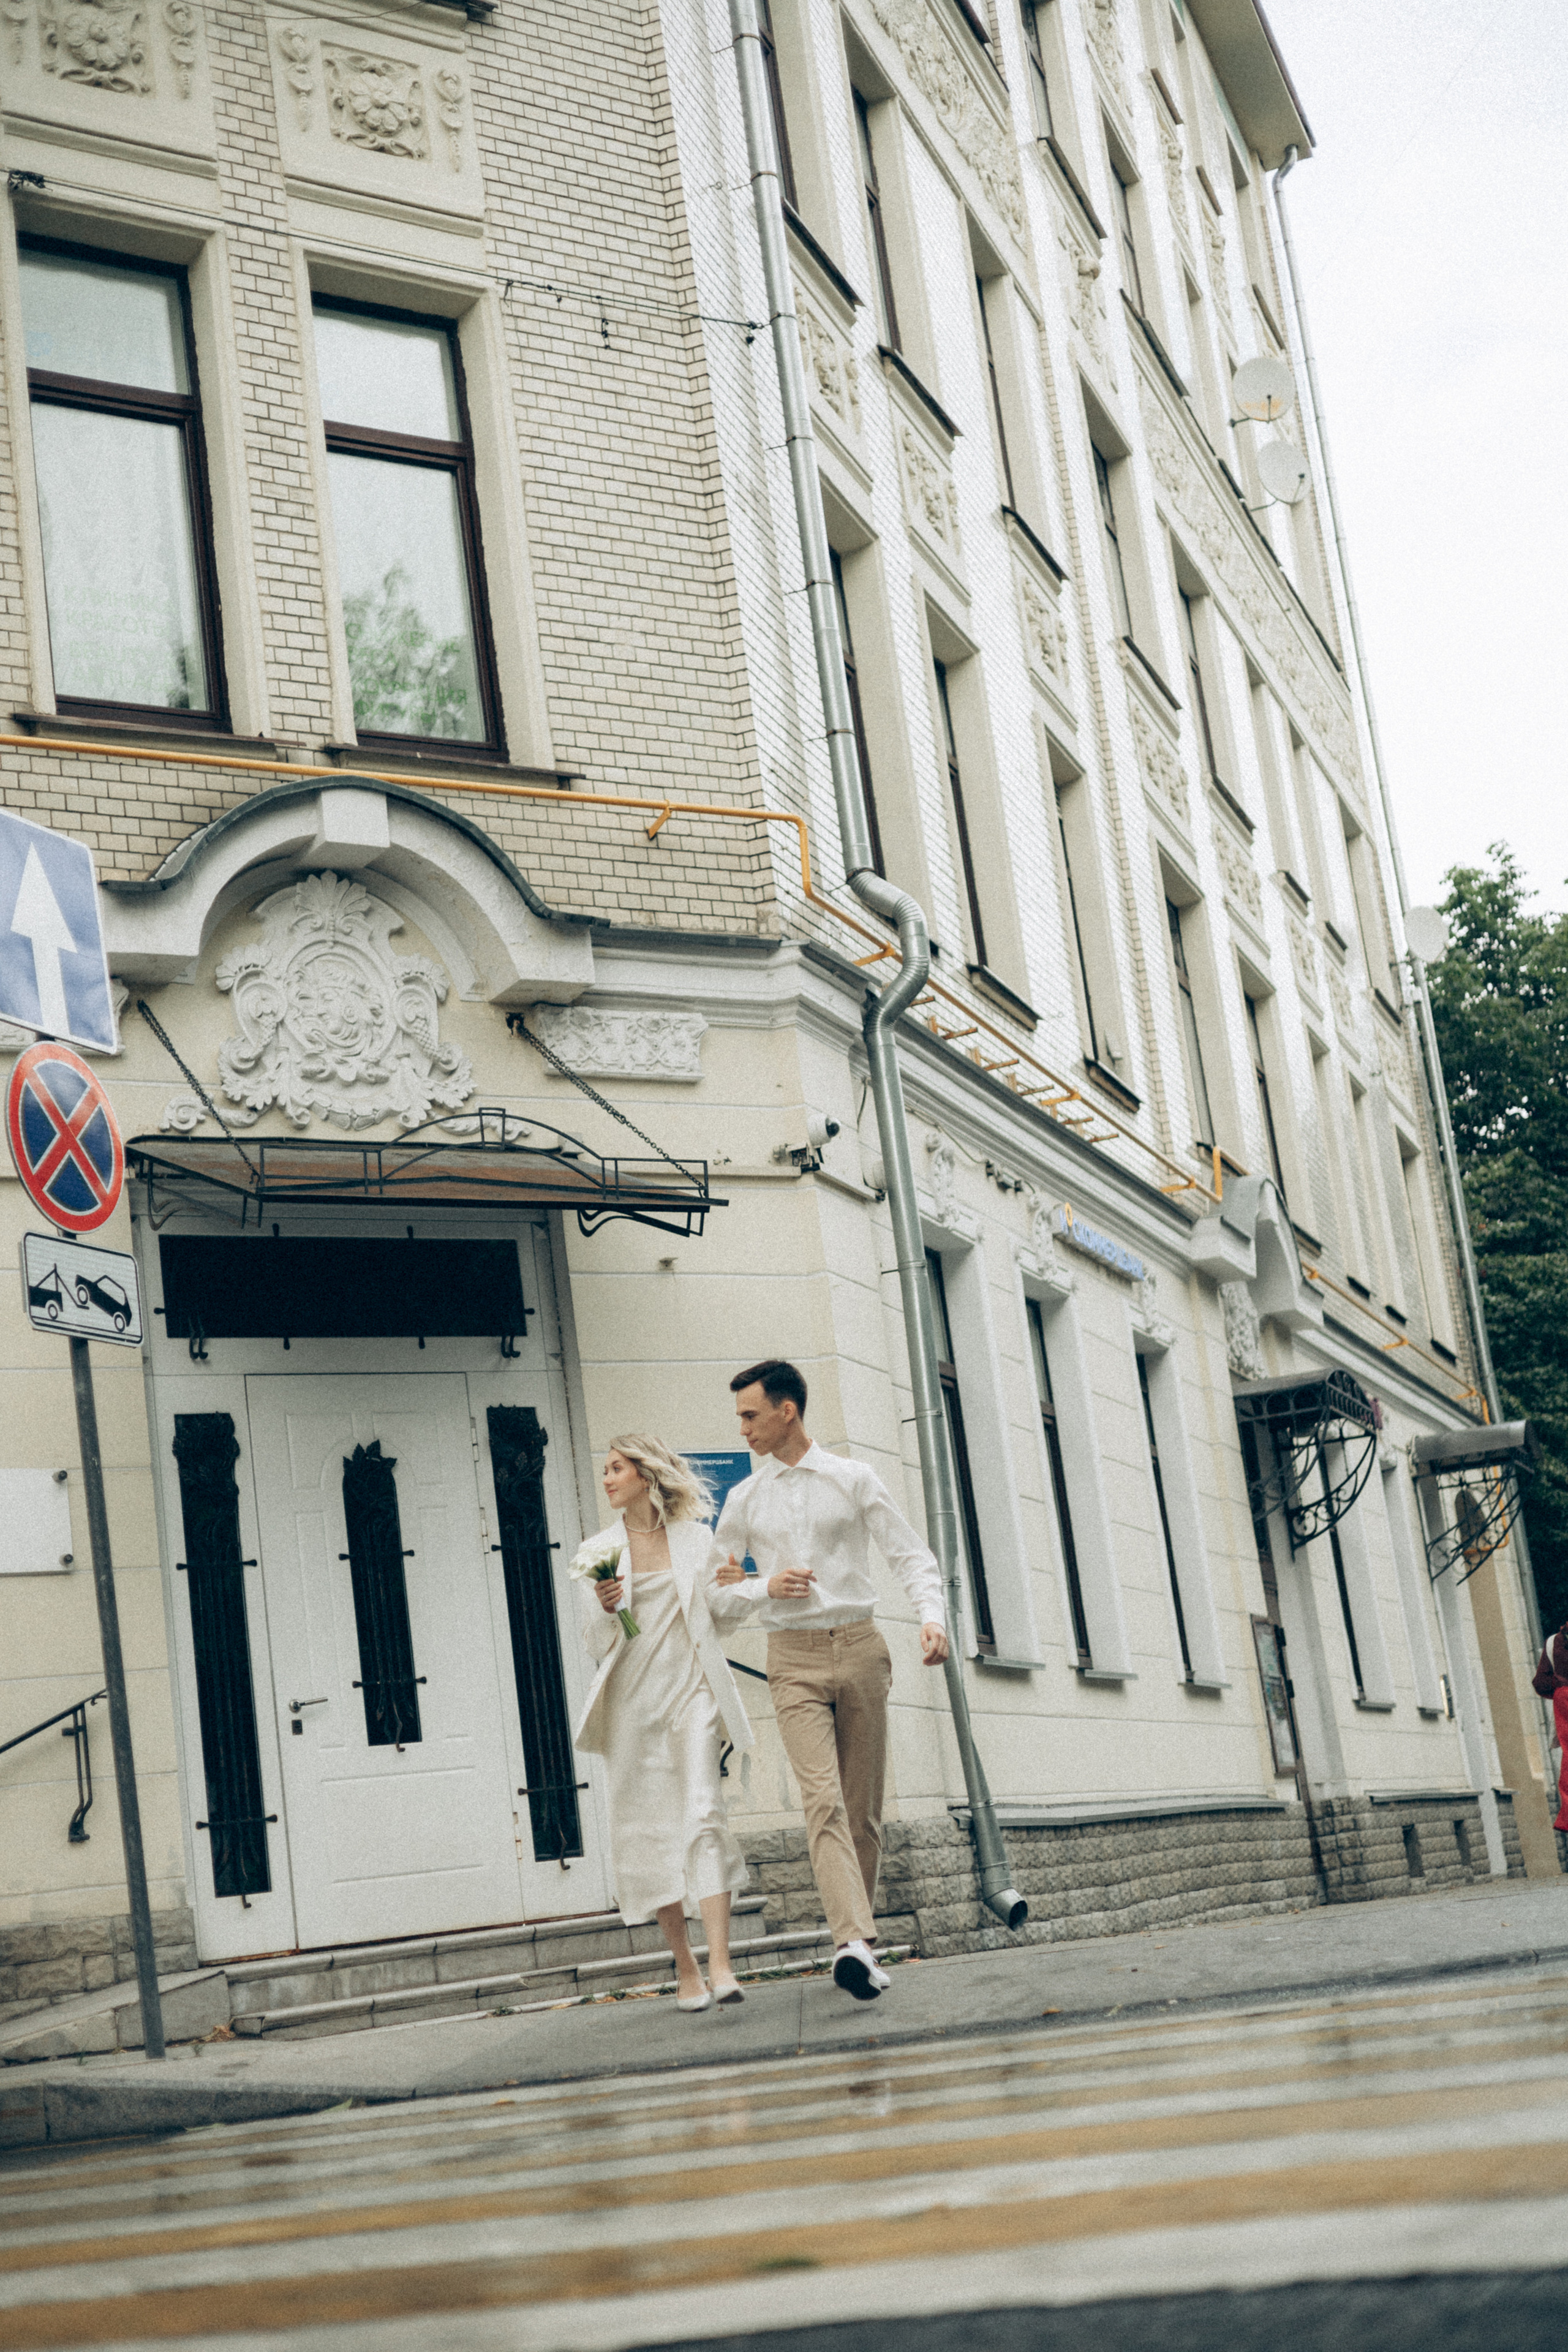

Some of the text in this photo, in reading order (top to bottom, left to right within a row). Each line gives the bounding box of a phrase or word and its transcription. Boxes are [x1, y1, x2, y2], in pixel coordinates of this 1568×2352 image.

[64, 585, 178, 615] КЛИНИКА
[66, 609, 171, 638] КРАСОТЫ
[69, 640, 155, 666] BEAUTY
